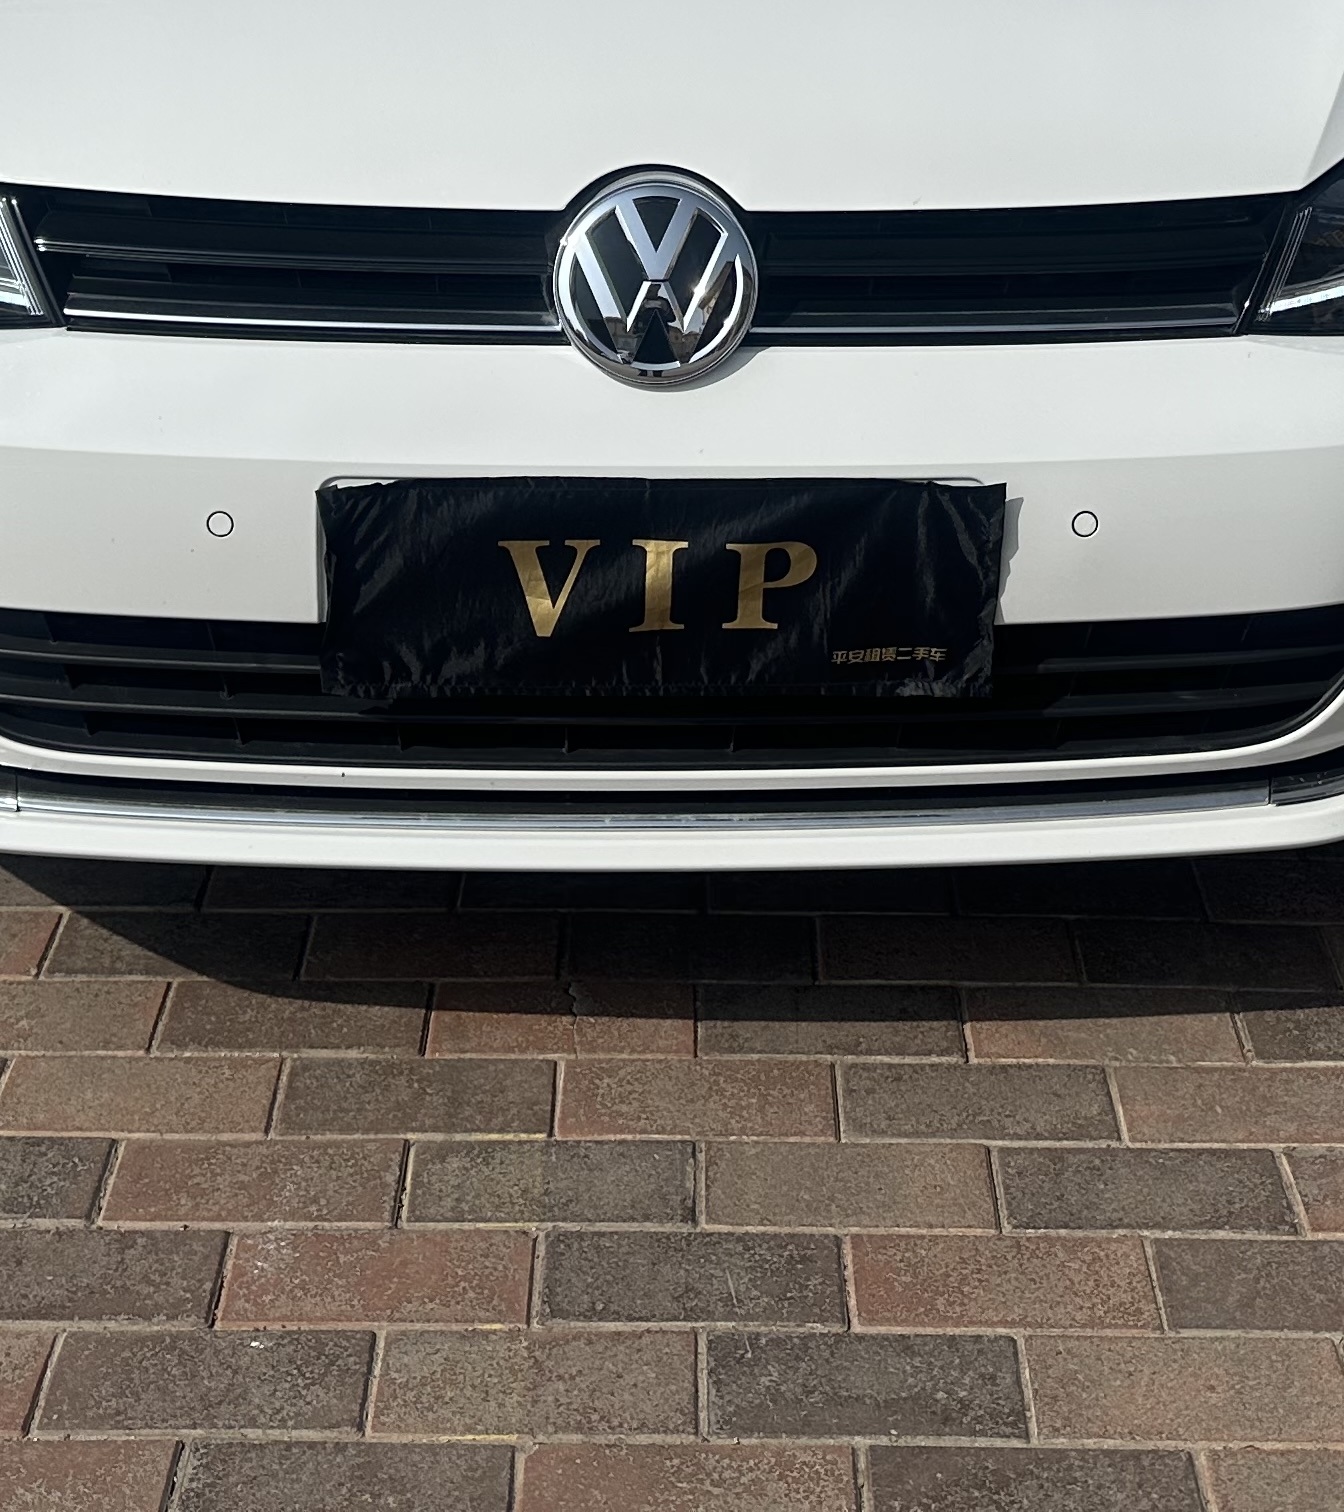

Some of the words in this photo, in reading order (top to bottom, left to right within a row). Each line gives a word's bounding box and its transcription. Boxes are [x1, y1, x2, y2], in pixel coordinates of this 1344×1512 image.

[497, 538, 818, 637] VIP
[831, 646, 948, 665] 平安租赁二手车
